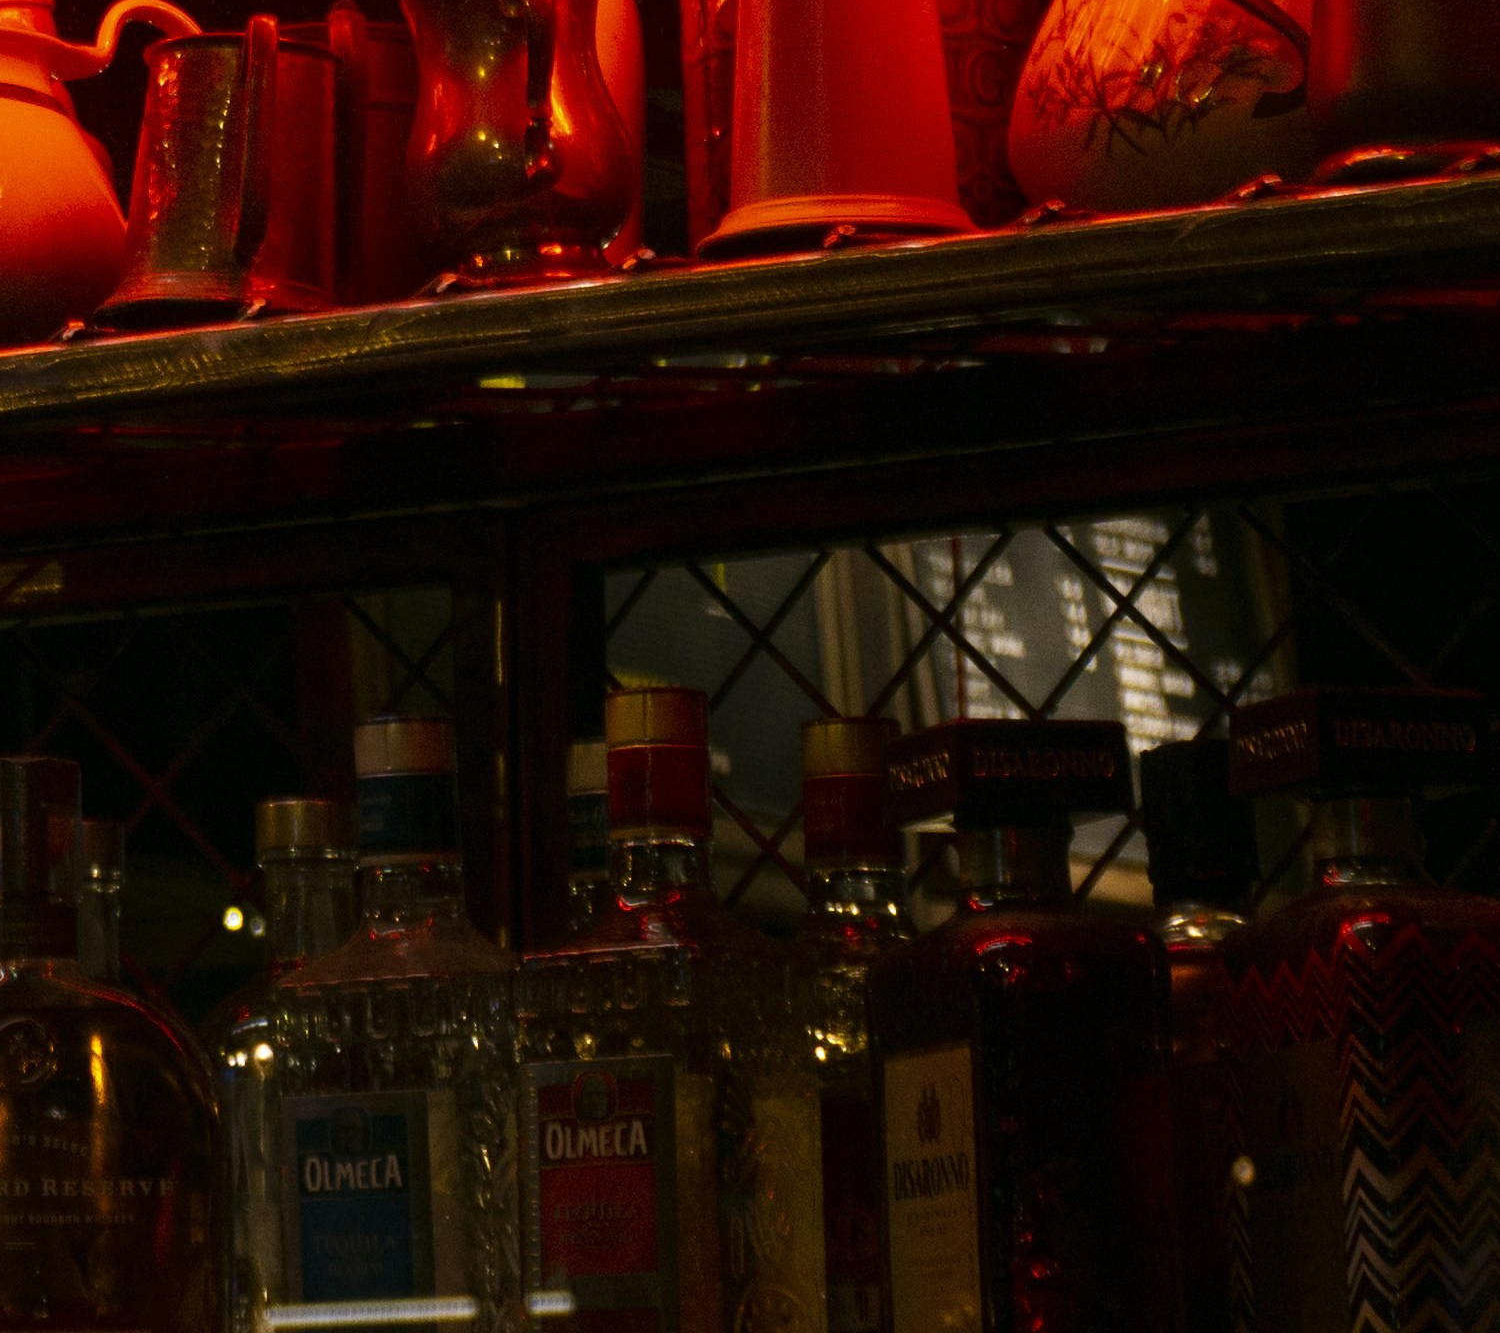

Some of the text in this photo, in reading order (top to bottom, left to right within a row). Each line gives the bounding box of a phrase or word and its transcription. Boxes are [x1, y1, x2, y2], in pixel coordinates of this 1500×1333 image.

[545, 1119, 648, 1161] OLMECA
[40, 1177, 177, 1198] RESERVE
[304, 1154, 403, 1193] OLMECA
[894, 1152, 970, 1201] DISARONNO
